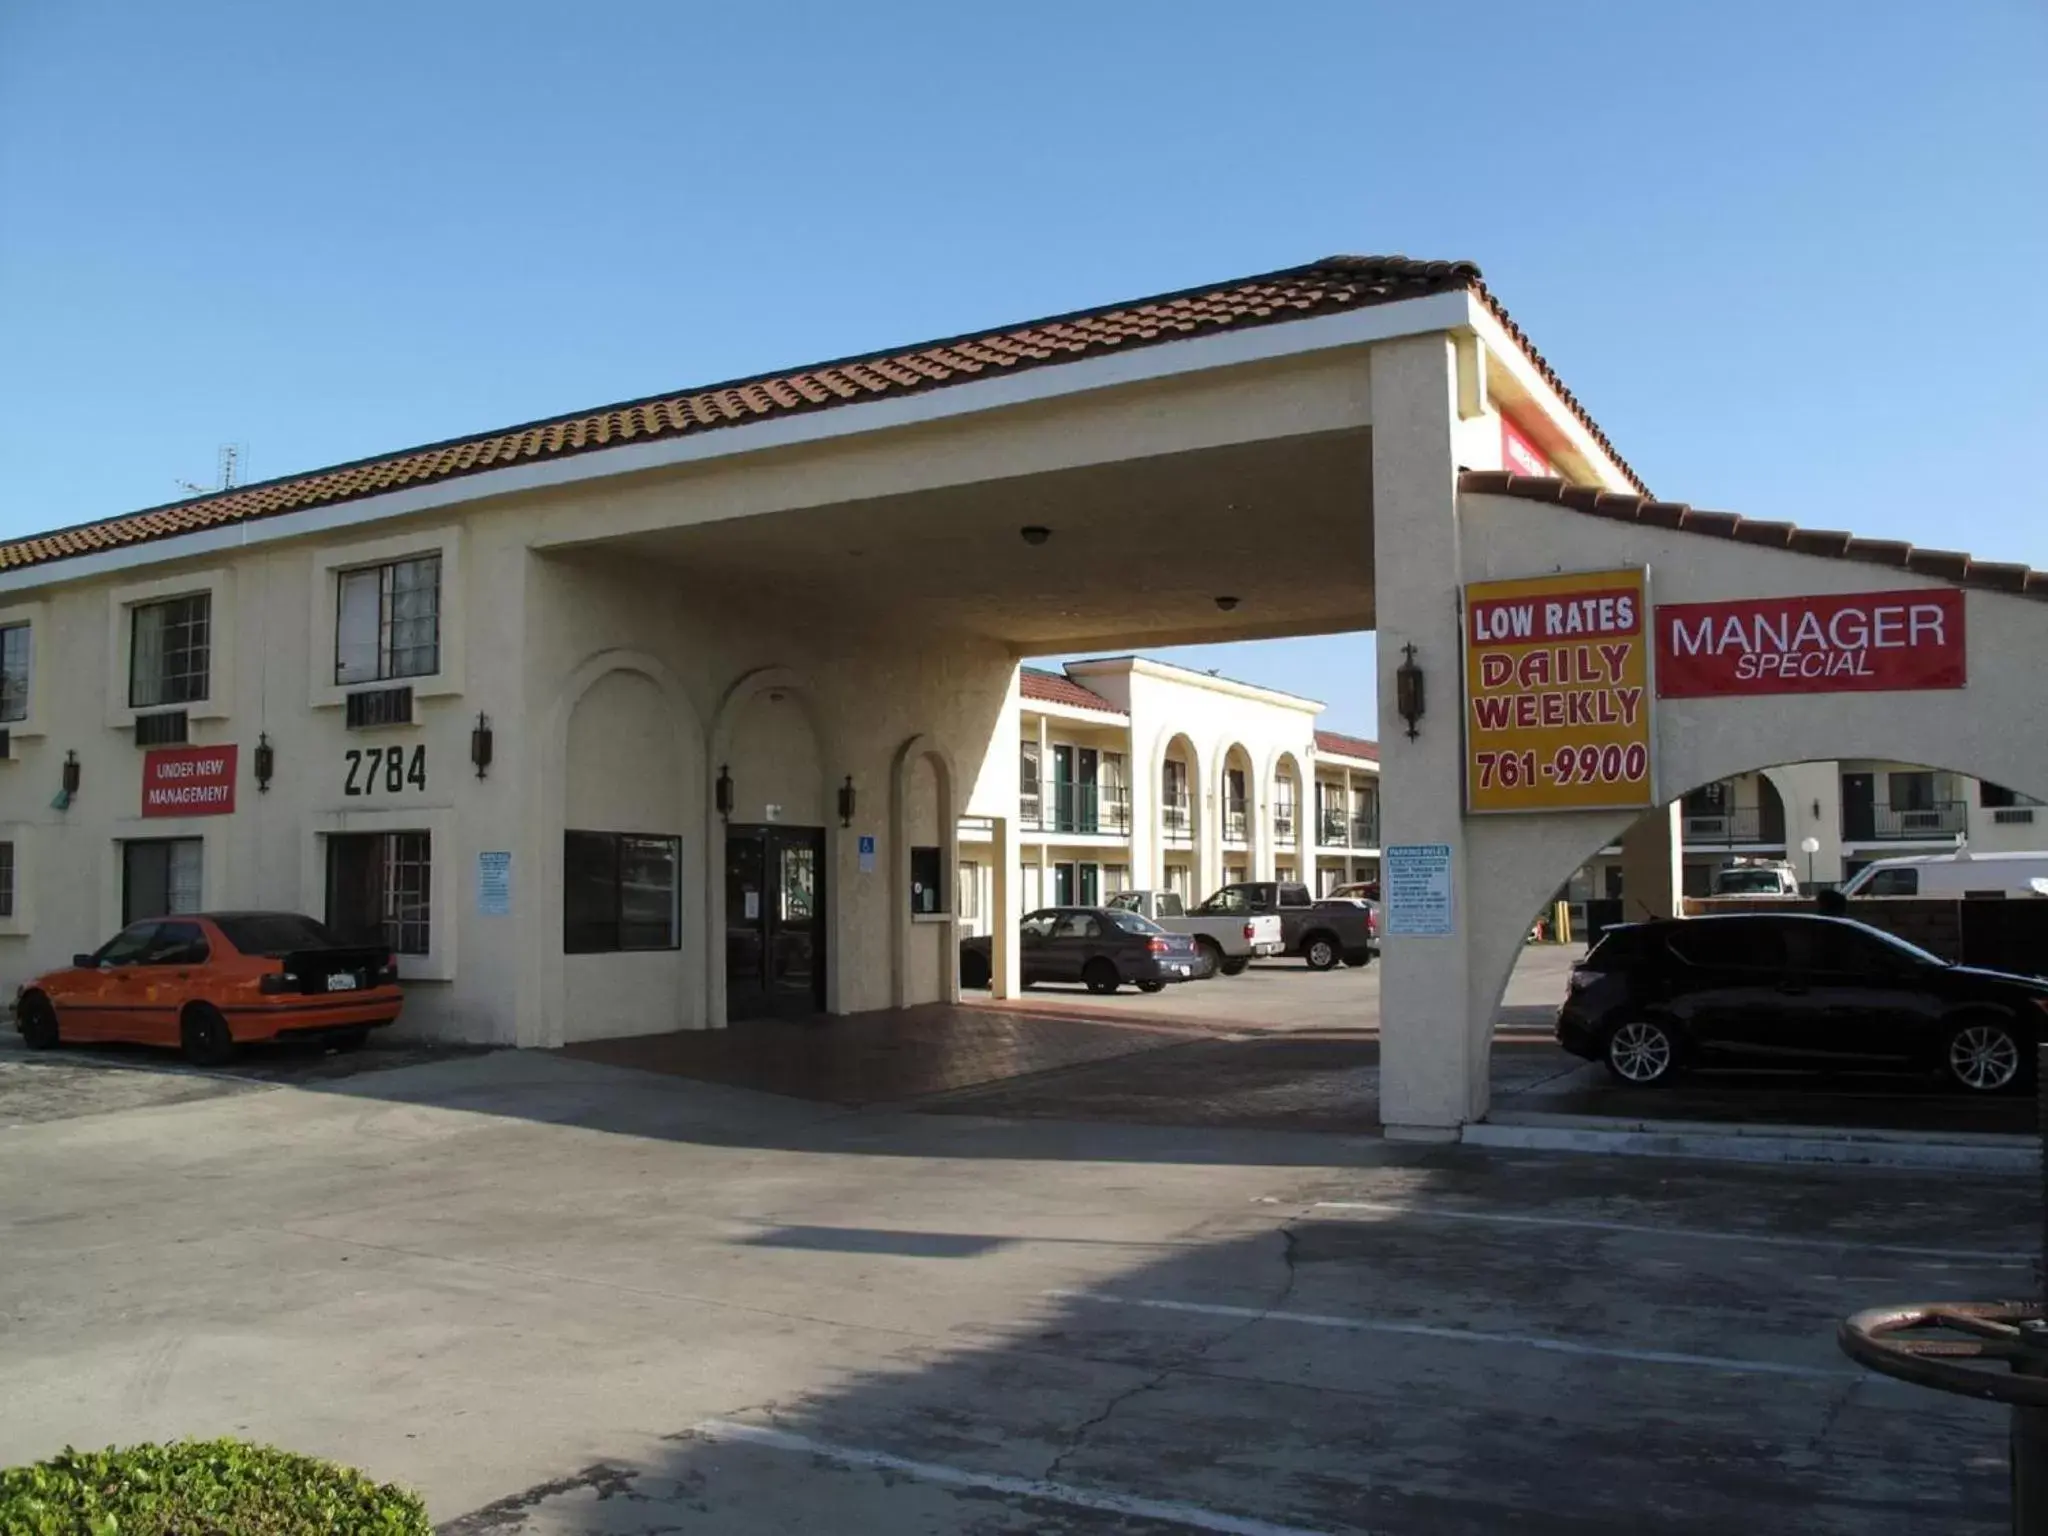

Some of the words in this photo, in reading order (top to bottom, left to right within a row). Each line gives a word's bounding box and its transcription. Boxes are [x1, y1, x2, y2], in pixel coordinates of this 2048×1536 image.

[1476, 604, 1534, 641] LOW
[1545, 596, 1634, 636] RATES
[1672, 604, 1945, 657] MANAGER
[1481, 643, 1632, 690] DAILY
[1735, 649, 1875, 680] SPECIAL
[1473, 686, 1643, 732] WEEKLY
[156, 761, 195, 779] UNDER
[196, 759, 225, 776] NEW
[345, 744, 426, 797] 2784
[1476, 741, 1647, 789] 761-9900
[149, 784, 229, 805] MANAGEMENT
